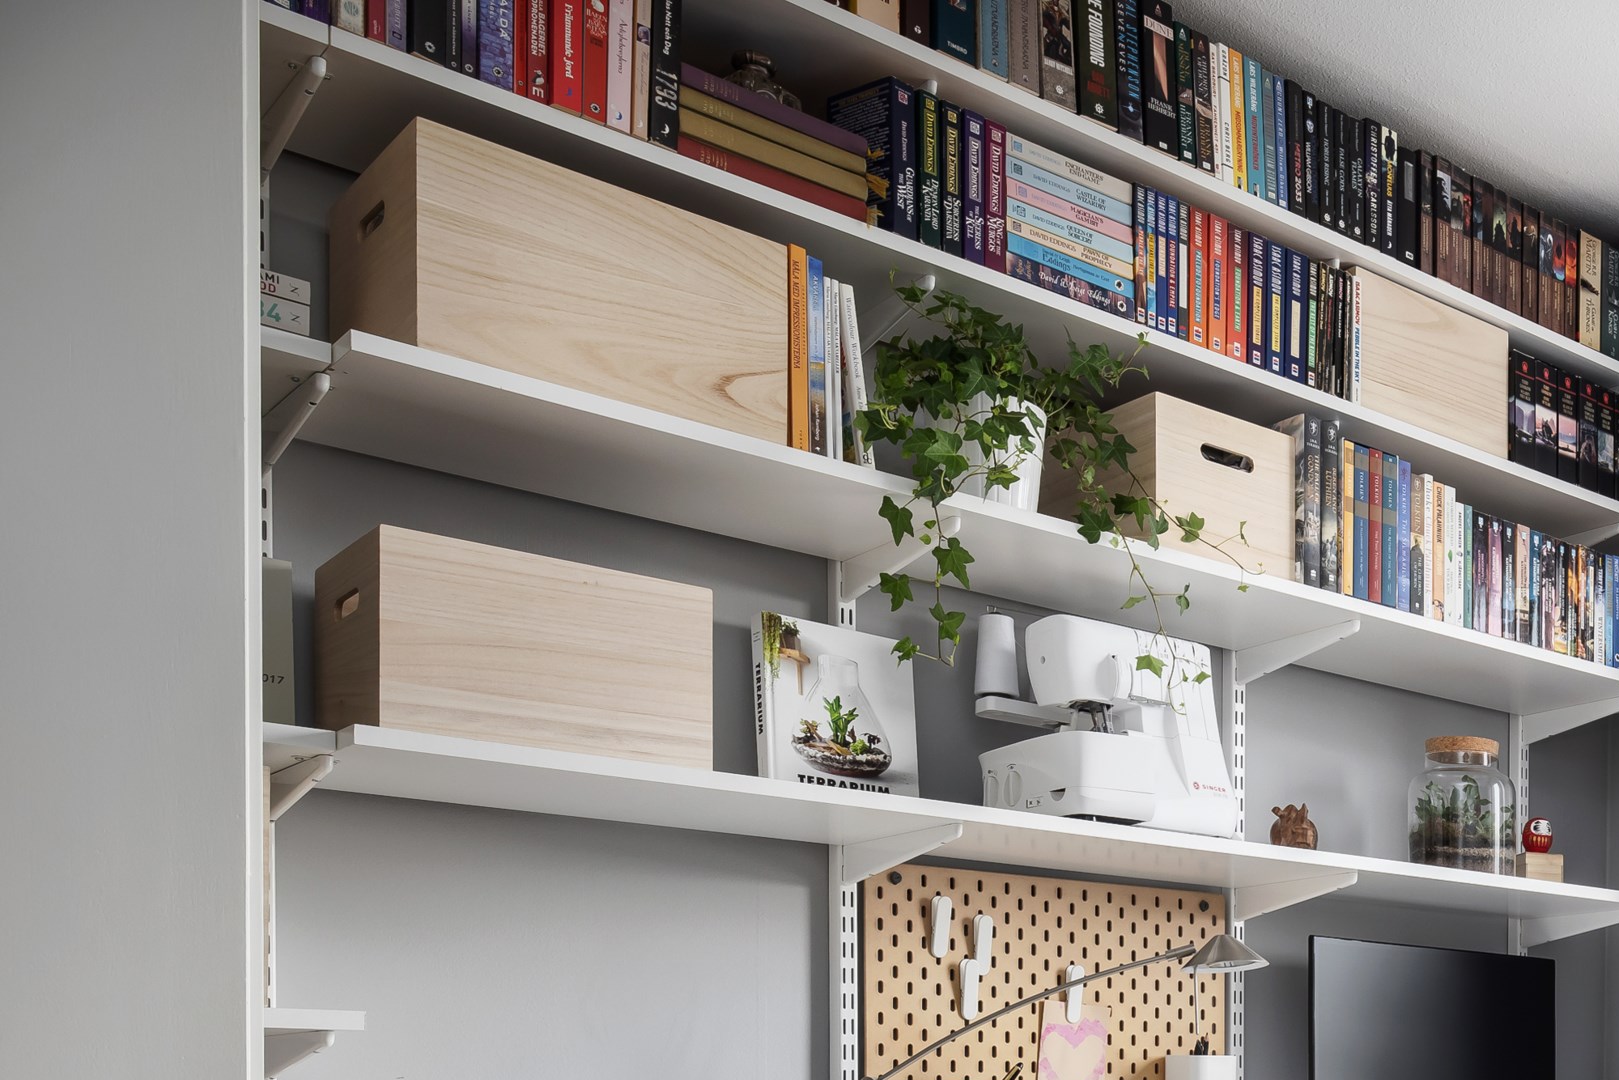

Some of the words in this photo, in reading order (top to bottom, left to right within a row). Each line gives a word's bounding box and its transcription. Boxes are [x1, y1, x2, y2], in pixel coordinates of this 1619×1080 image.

[538, 12, 546, 53] BAGERIET
[564, 4, 573, 57] Främmande
[1088, 8, 1104, 67] FOUNDING
[1117, 2, 1126, 72] SEVENEVES
[1144, 18, 1173, 38] DUNE
[663, 42, 671, 56] Dag
[947, 40, 968, 54] TIMBRO
[564, 57, 574, 78] jord
[1126, 24, 1139, 100] STEPHENSON
[655, 68, 678, 111] 1793
[1150, 98, 1172, 112] FRANK
[926, 112, 934, 136] DAVID
[948, 128, 956, 154] DAVID
[971, 140, 979, 164] DAVID
[1235, 111, 1243, 173] MIDSOMMARGRYNING
[1251, 115, 1259, 170] MIDVINTERMÖRKER
[926, 137, 935, 172] EDDINGS
[991, 146, 1001, 171] DAVID
[1370, 125, 1378, 183] CHRISTOFFER
[948, 155, 957, 192] EDDINGS
[970, 165, 979, 198] EDDINGS
[897, 184, 907, 209] WEST
[904, 167, 915, 214] GUARDIANS
[922, 185, 932, 221] KARANDA
[930, 179, 939, 208] DEMON
[991, 172, 1001, 212] EDDINGS
[1076, 188, 1097, 200] CASTLE
[1076, 195, 1106, 211] WIZARDRY
[932, 208, 940, 230] LORD
[944, 200, 954, 239] DARSHIVA
[953, 197, 961, 241] SORCERESS
[966, 216, 975, 238] KELL
[996, 217, 1005, 238] KING
[1032, 214, 1045, 222] DAVID
[1066, 224, 1085, 235] QUEEN
[1075, 214, 1099, 228] GAMBIT
[975, 216, 984, 250] SEERESS
[987, 215, 996, 252] MURGOS
[1030, 229, 1049, 242] DAVID
[1049, 235, 1076, 252] EDDINGS
[1067, 231, 1092, 245] SORCERY
[1083, 247, 1101, 258] PAWN
[1253, 237, 1263, 258] ISAAC
[1272, 246, 1281, 265] ISAAC
[792, 259, 800, 281] MÅLA
[1042, 254, 1071, 274] Eddings
[1080, 253, 1112, 268] PROPHECY
[1253, 258, 1263, 286] ASIMOV
[1293, 255, 1301, 272] ISAAC
[1038, 271, 1060, 284] David
[1087, 289, 1110, 306] Eddings
[1272, 266, 1282, 294] ASIMOV
[1293, 272, 1301, 296] ASIMOV
[845, 296, 857, 340] Watercolour
[851, 343, 861, 379] Workbook
[855, 386, 863, 400] Anne
[755, 662, 764, 735] TERRARIUM
[1202, 784, 1226, 792] SINGER
